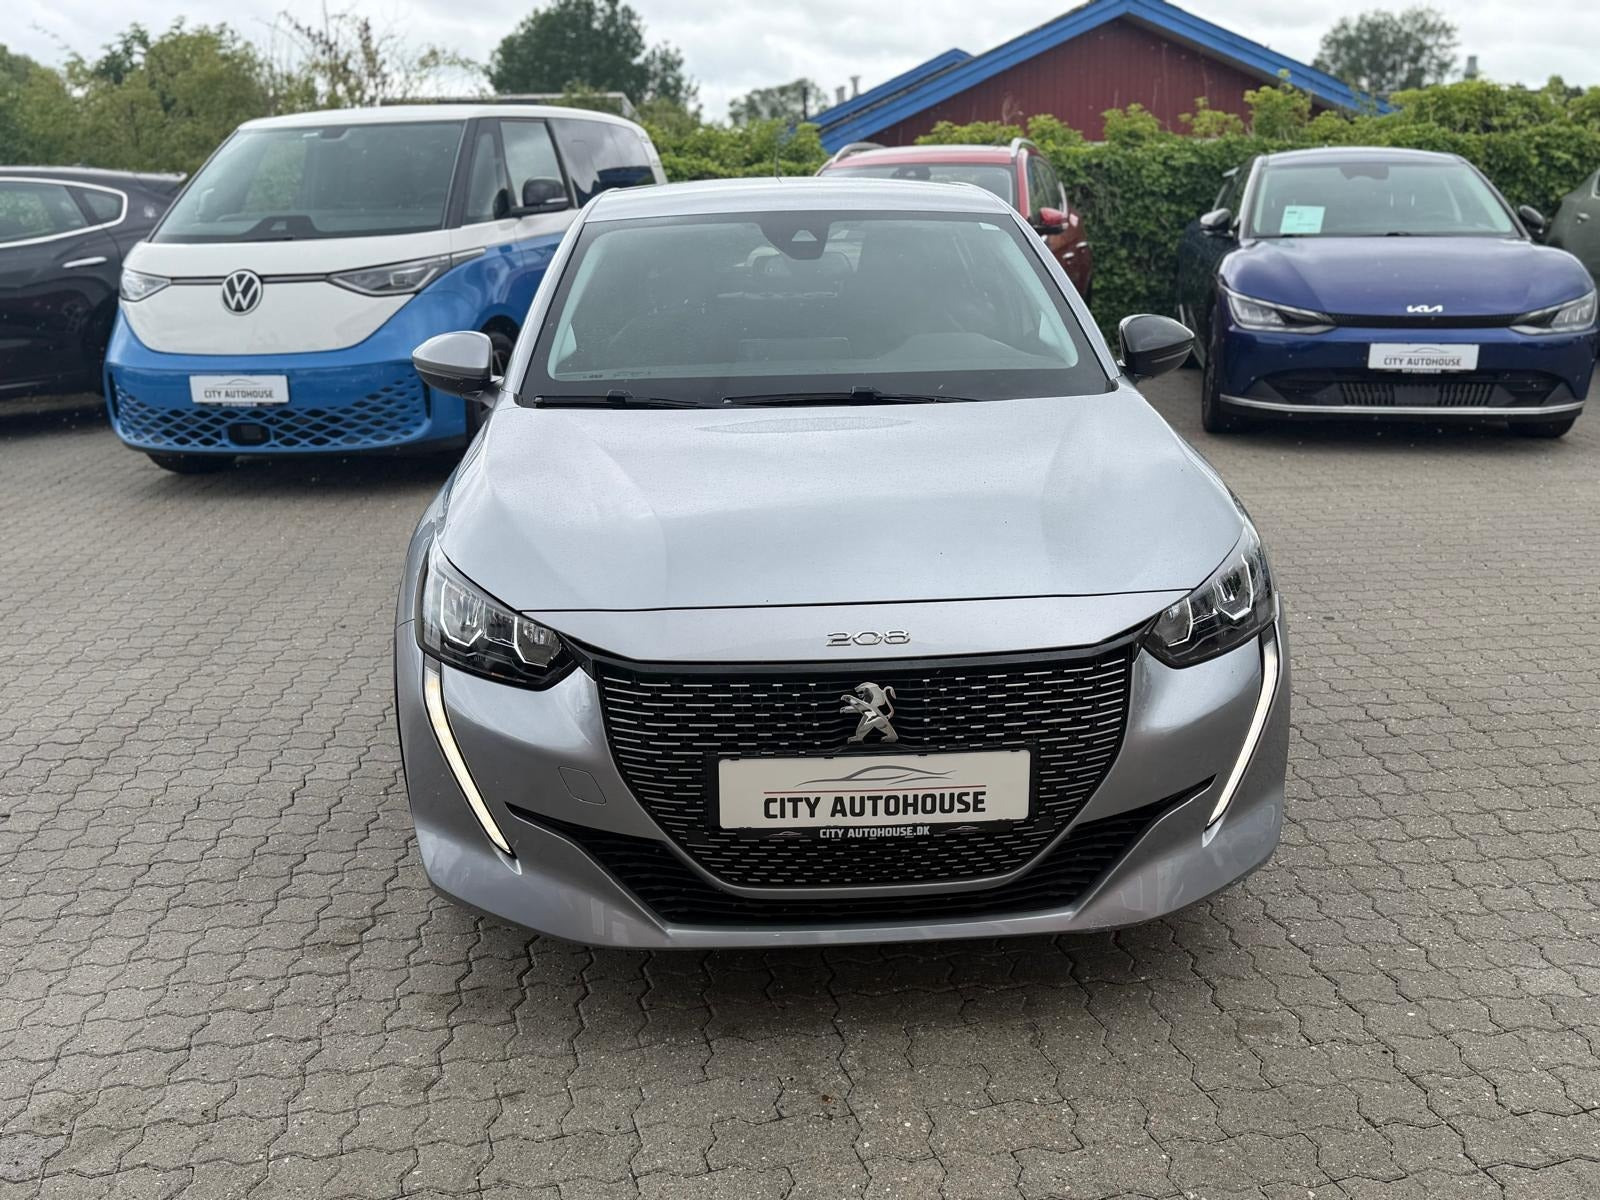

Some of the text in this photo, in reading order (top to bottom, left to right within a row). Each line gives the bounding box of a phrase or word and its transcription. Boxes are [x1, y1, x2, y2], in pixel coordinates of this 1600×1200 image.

[1384, 357, 1461, 366] CITY AUTOHOUSE
[204, 390, 274, 399] CITY AUTOHOUSE
[825, 629, 911, 647] 208
[763, 791, 987, 819] CITY AUTOHOUSE
[820, 825, 930, 838] CITY AUTOHOUSE.DK
